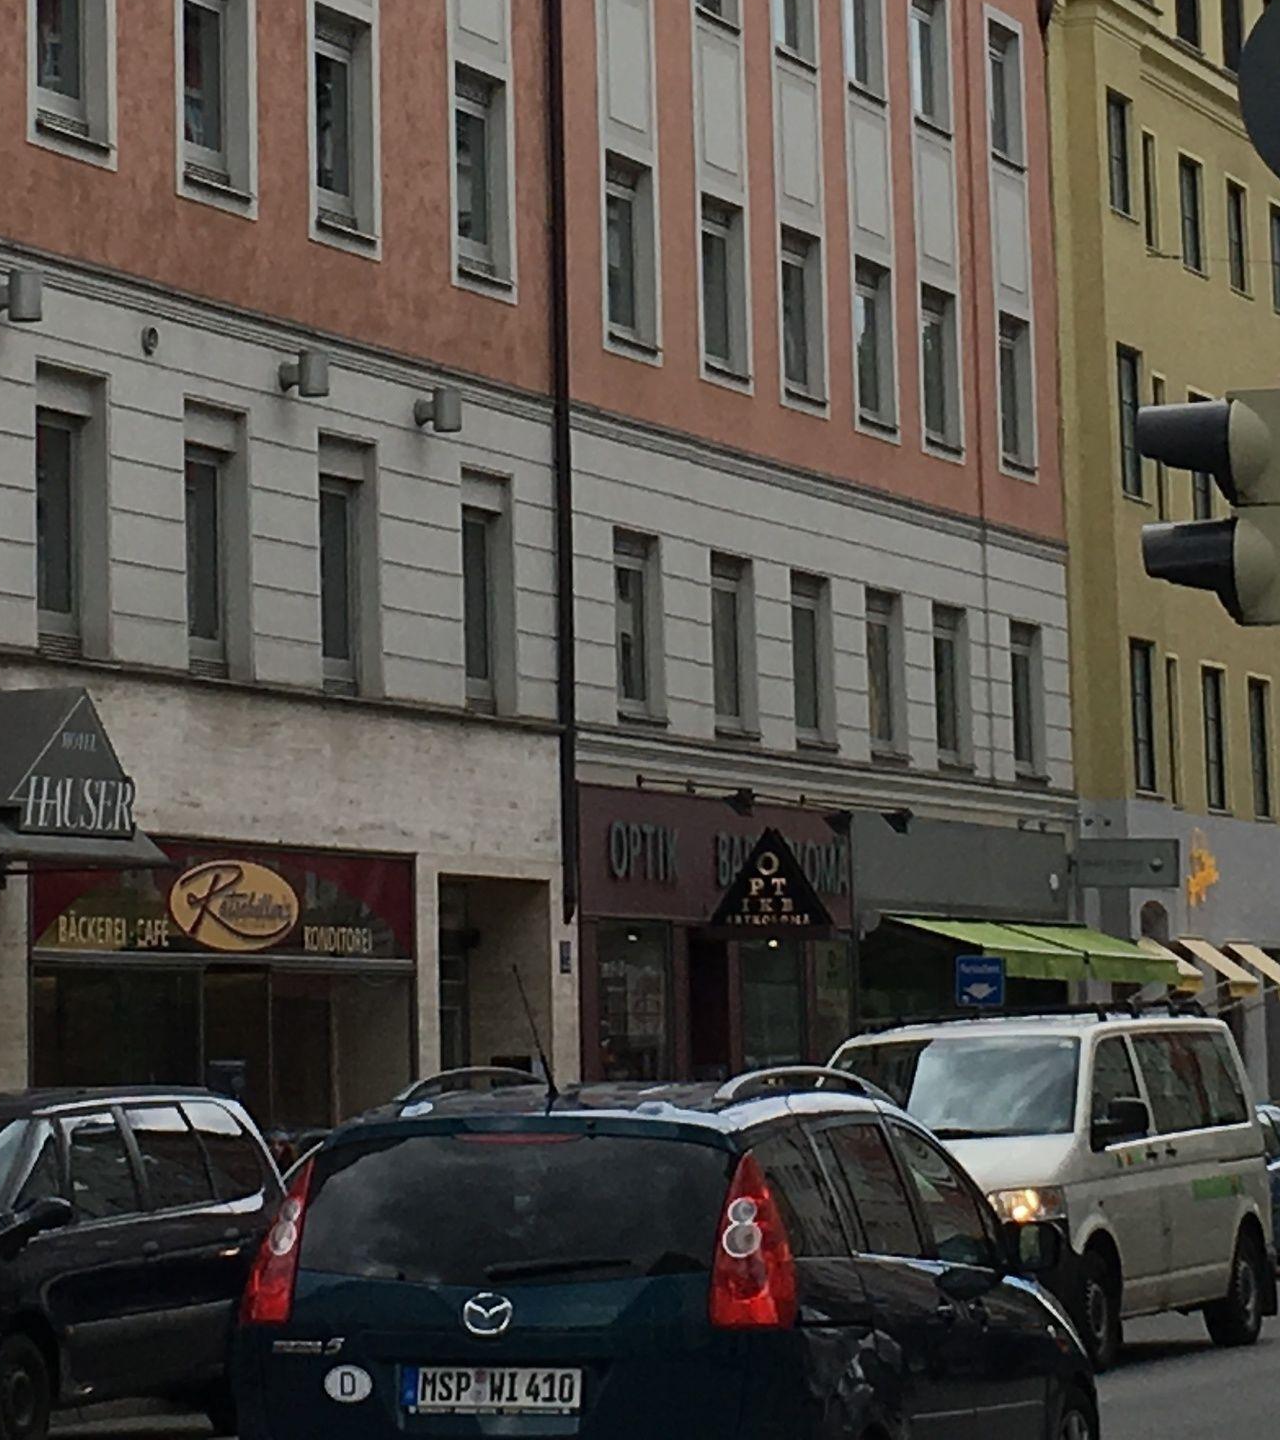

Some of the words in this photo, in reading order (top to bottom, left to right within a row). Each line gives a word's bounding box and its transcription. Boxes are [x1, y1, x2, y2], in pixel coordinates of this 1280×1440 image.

[23, 775, 134, 832] HAUSER
[610, 820, 679, 882] OPTIK
[58, 911, 127, 947] BÄCKEREI
[137, 914, 170, 948] CAFÉ
[303, 925, 373, 954] KONDITOREI
[340, 1372, 356, 1397] D
[421, 1372, 471, 1403] MSP
[488, 1371, 519, 1403] WI
[525, 1371, 575, 1403] 410
